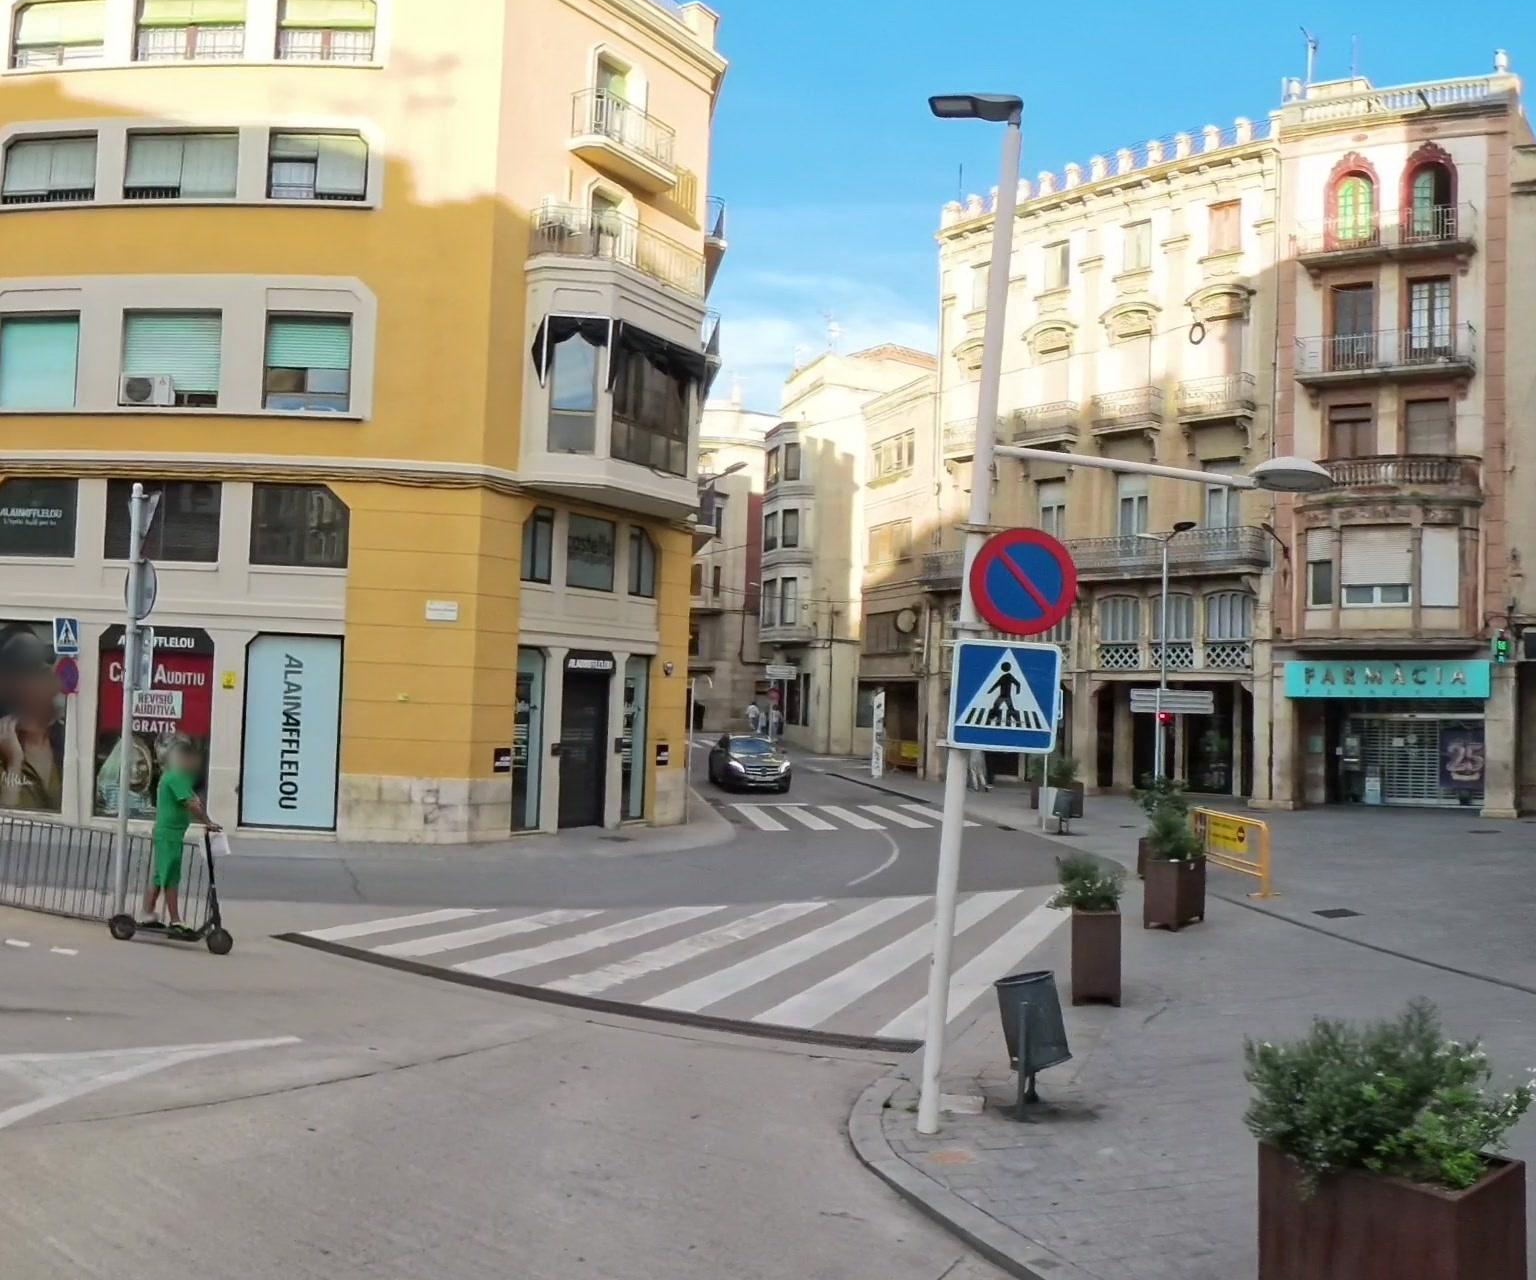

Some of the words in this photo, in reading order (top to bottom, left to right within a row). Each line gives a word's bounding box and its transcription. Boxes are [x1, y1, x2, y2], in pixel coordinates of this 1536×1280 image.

[1303, 662, 1468, 686] FARMÀCIA
[134, 703, 176, 716] AUDITIVA
[131, 720, 177, 734] GRATIS
[1446, 741, 1485, 774] 25
